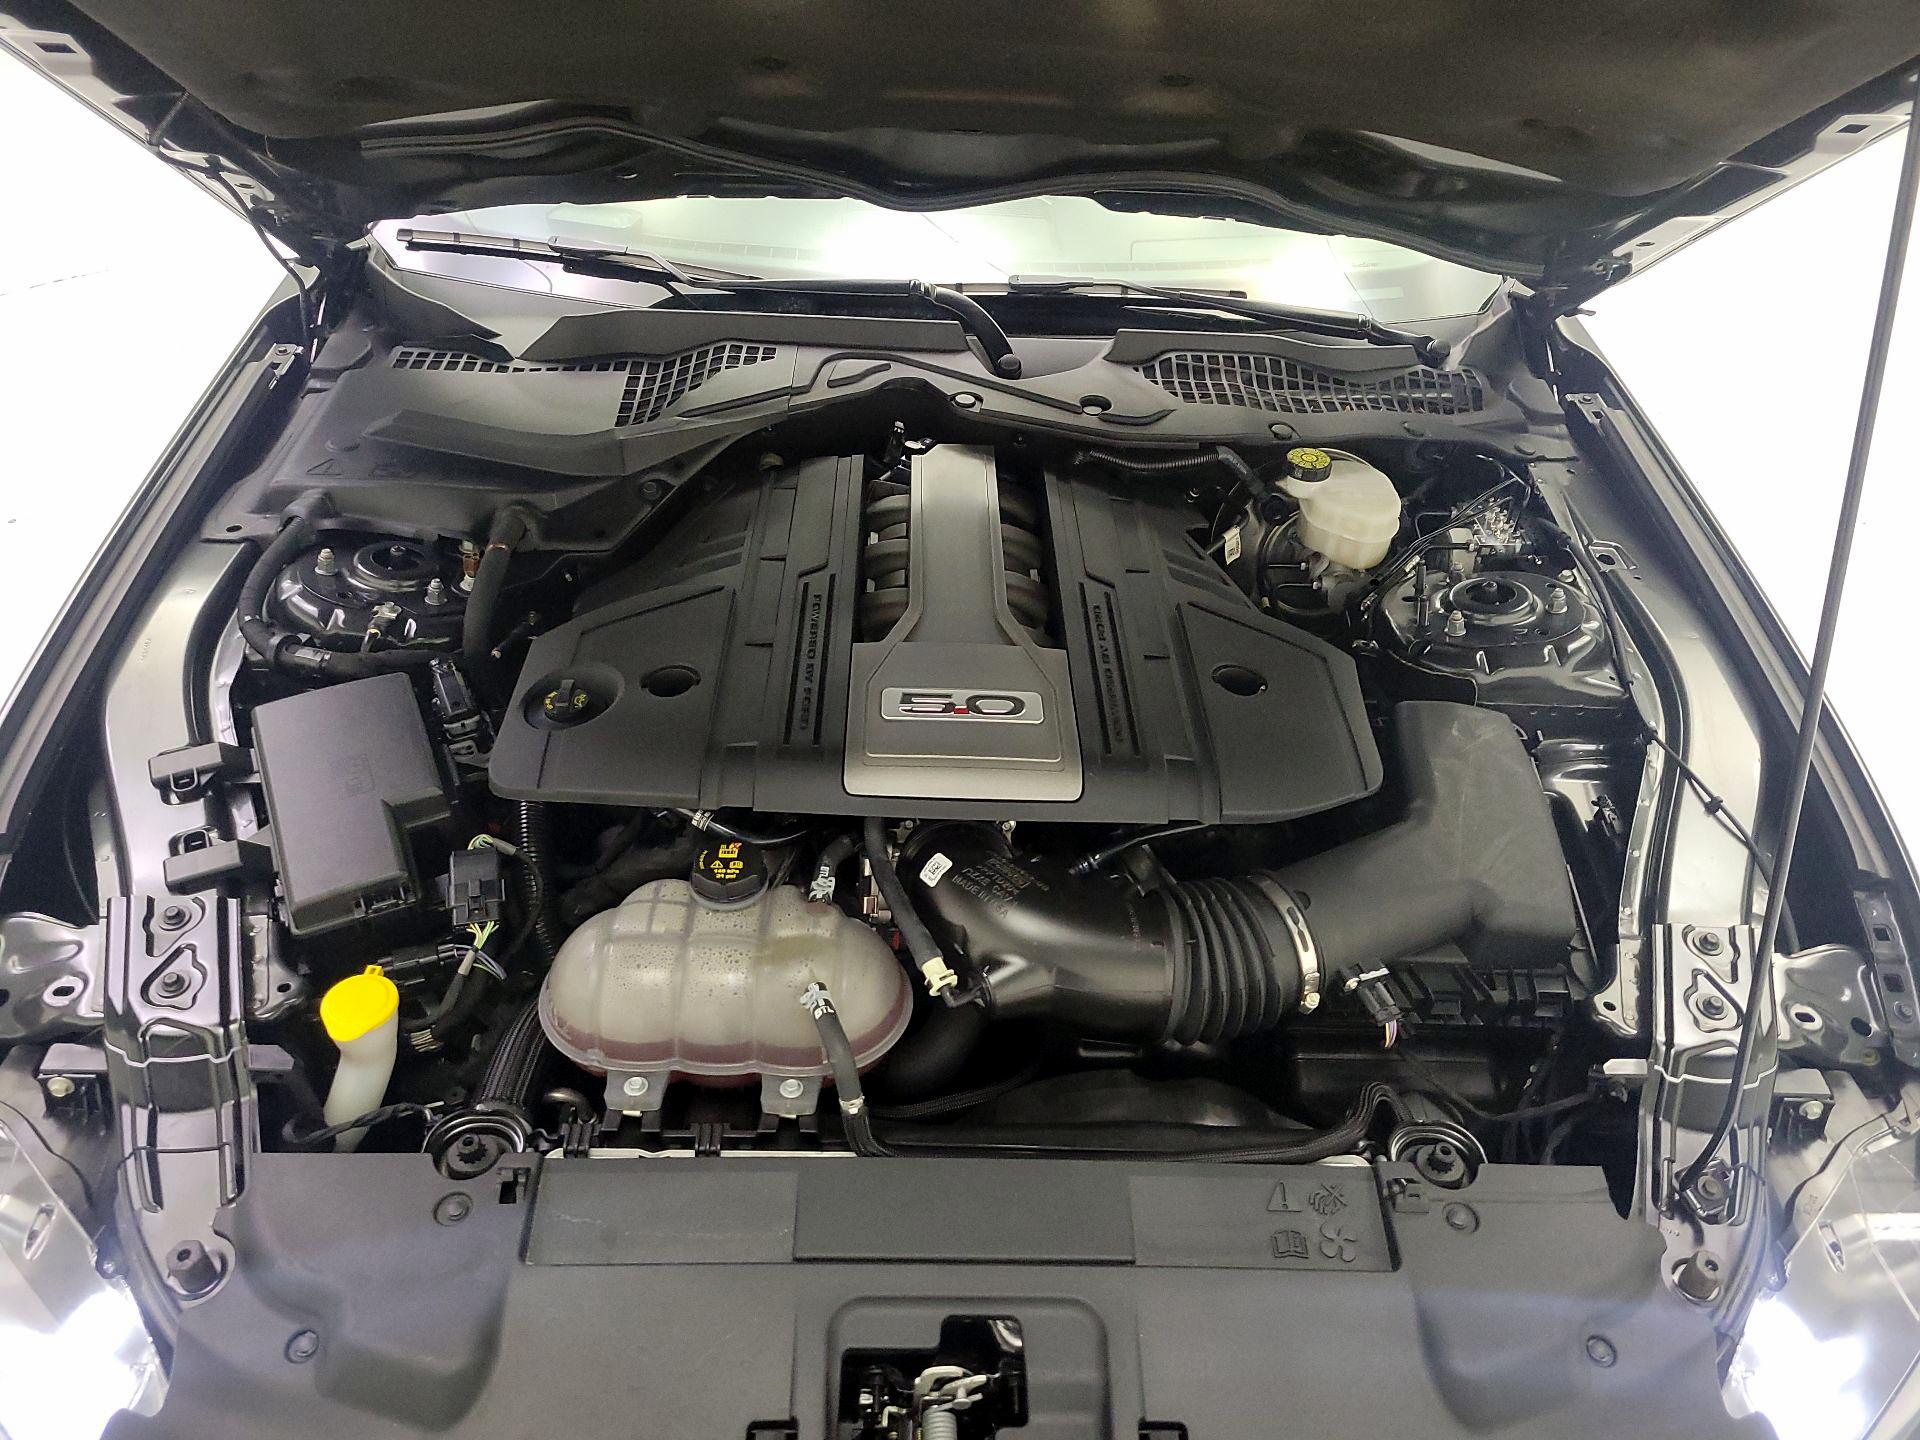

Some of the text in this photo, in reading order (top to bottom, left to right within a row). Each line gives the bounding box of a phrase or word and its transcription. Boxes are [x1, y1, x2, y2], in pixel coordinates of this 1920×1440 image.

[1092, 604, 1107, 641] FORD
[799, 594, 822, 730] POWERED BY FORD
[899, 693, 1026, 716] 5.0
[814, 1005, 835, 1020] BTL
